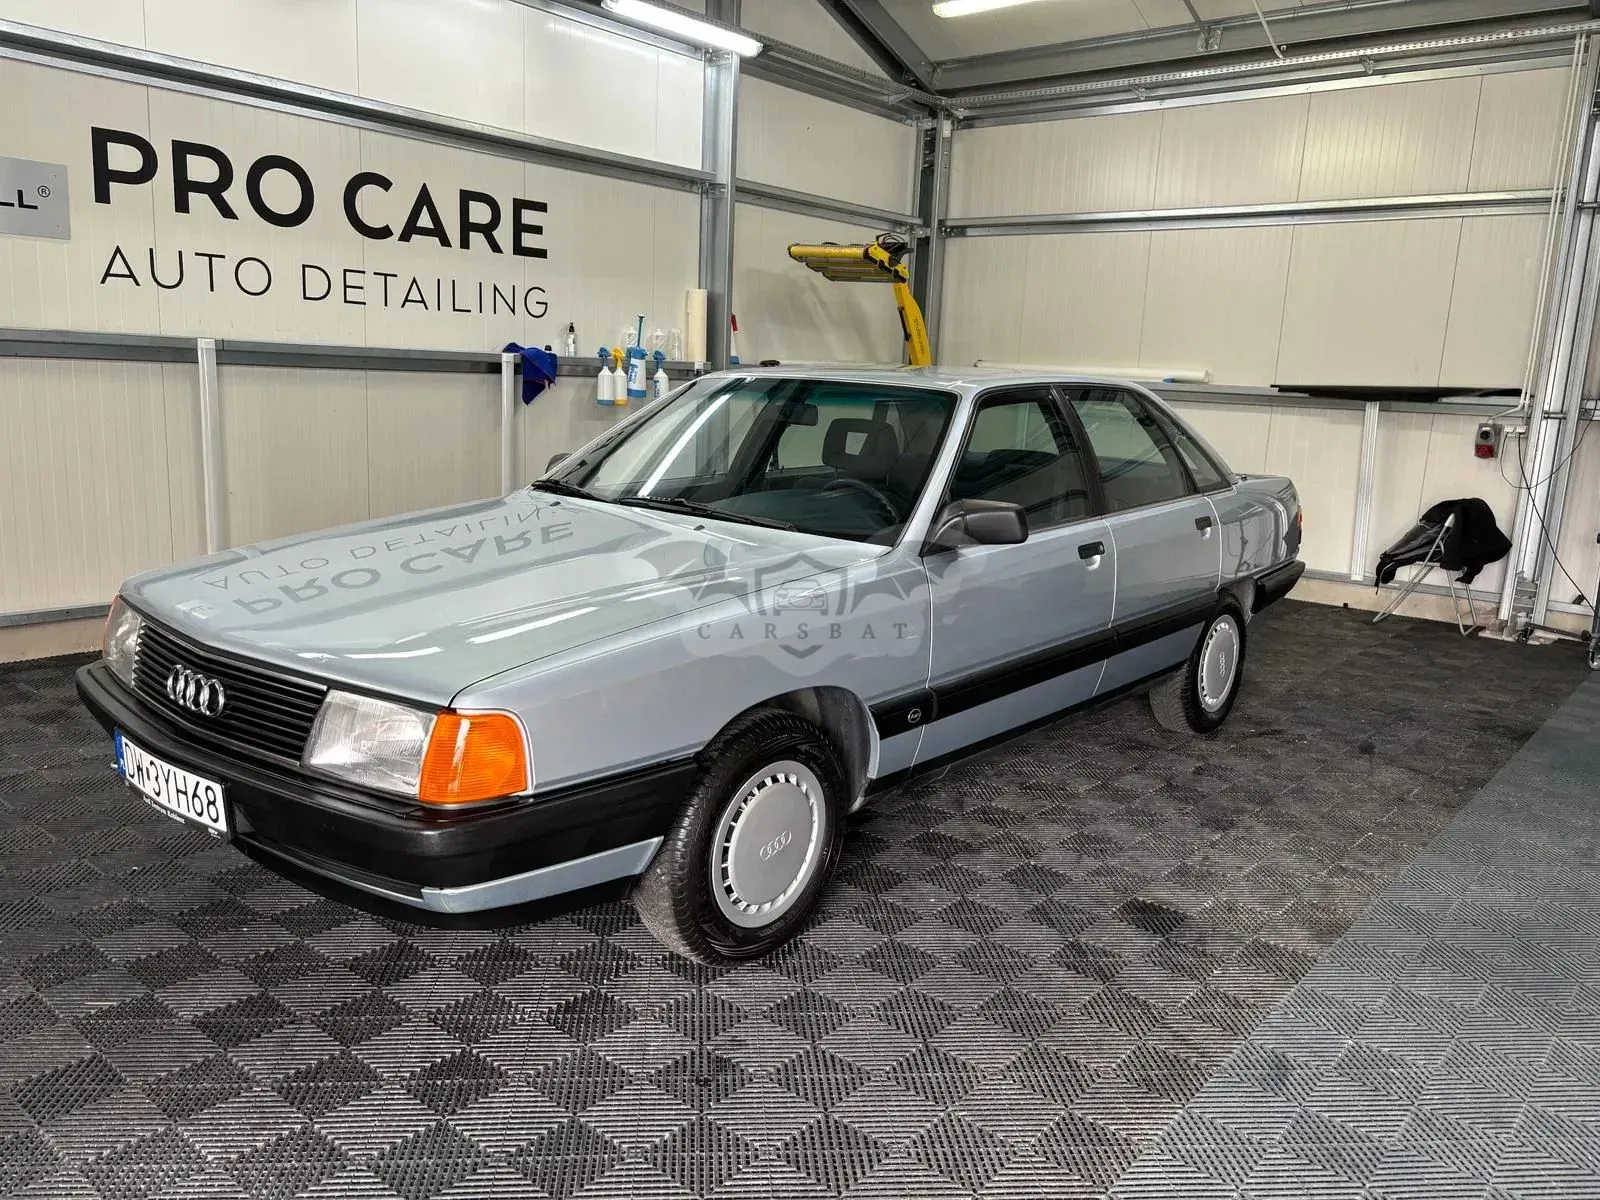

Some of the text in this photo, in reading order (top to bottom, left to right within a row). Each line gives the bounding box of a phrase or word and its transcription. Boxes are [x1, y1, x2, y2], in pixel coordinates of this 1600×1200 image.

[90, 126, 549, 260] PRO CARE
[99, 244, 550, 319] AUTO DETAILING
[149, 759, 219, 824] 3YH68
